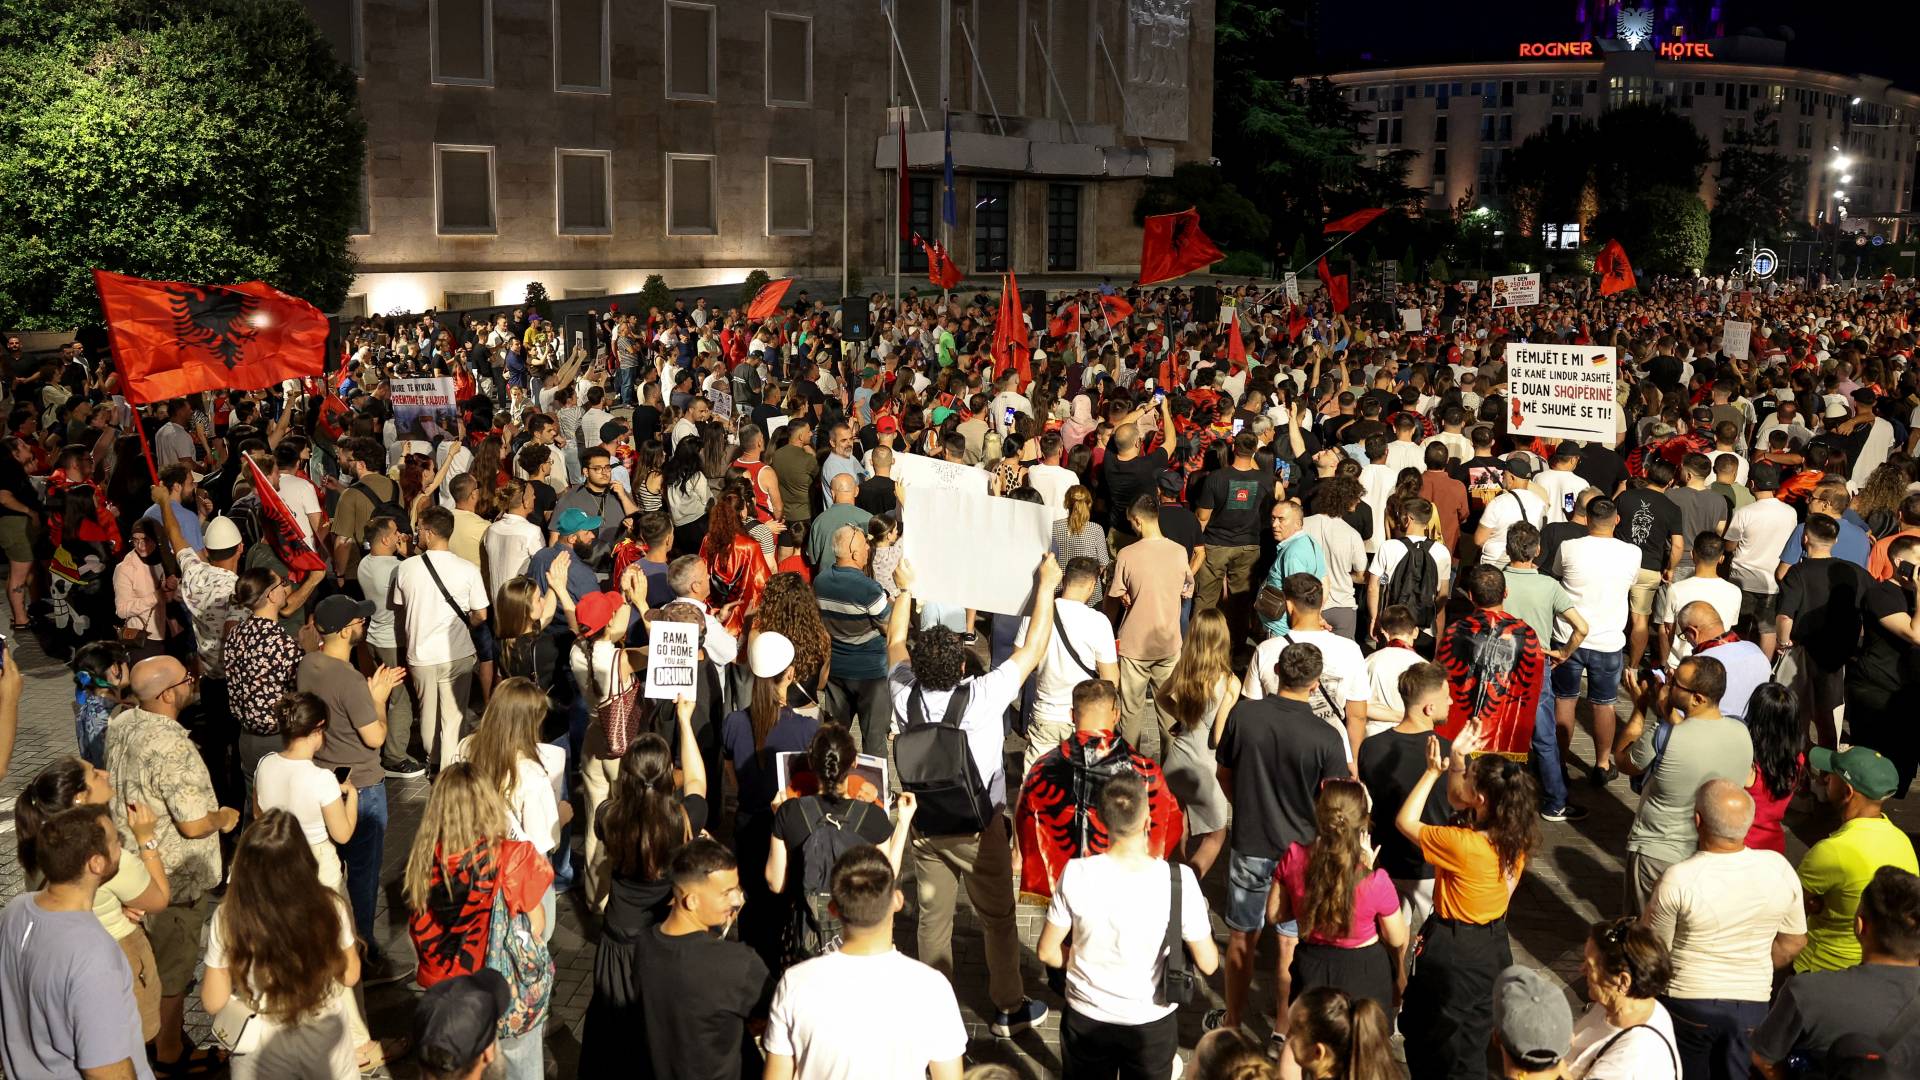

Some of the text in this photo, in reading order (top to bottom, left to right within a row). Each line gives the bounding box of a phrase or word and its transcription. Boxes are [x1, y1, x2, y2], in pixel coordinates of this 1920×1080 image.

[1520, 42, 1714, 57] ROGNER HOTEL
[1516, 349, 1583, 366] FËMIJËT E MI
[1511, 367, 1614, 385] QË KANË LINDUR JASHTË,
[1512, 382, 1517, 394] E
[1522, 382, 1550, 396] DUAN
[1523, 400, 1612, 419] MË SHUMË SE TI!
[663, 632, 688, 644] RAMA
[657, 645, 693, 657] GO HOME
[656, 667, 692, 685] DRUNK
